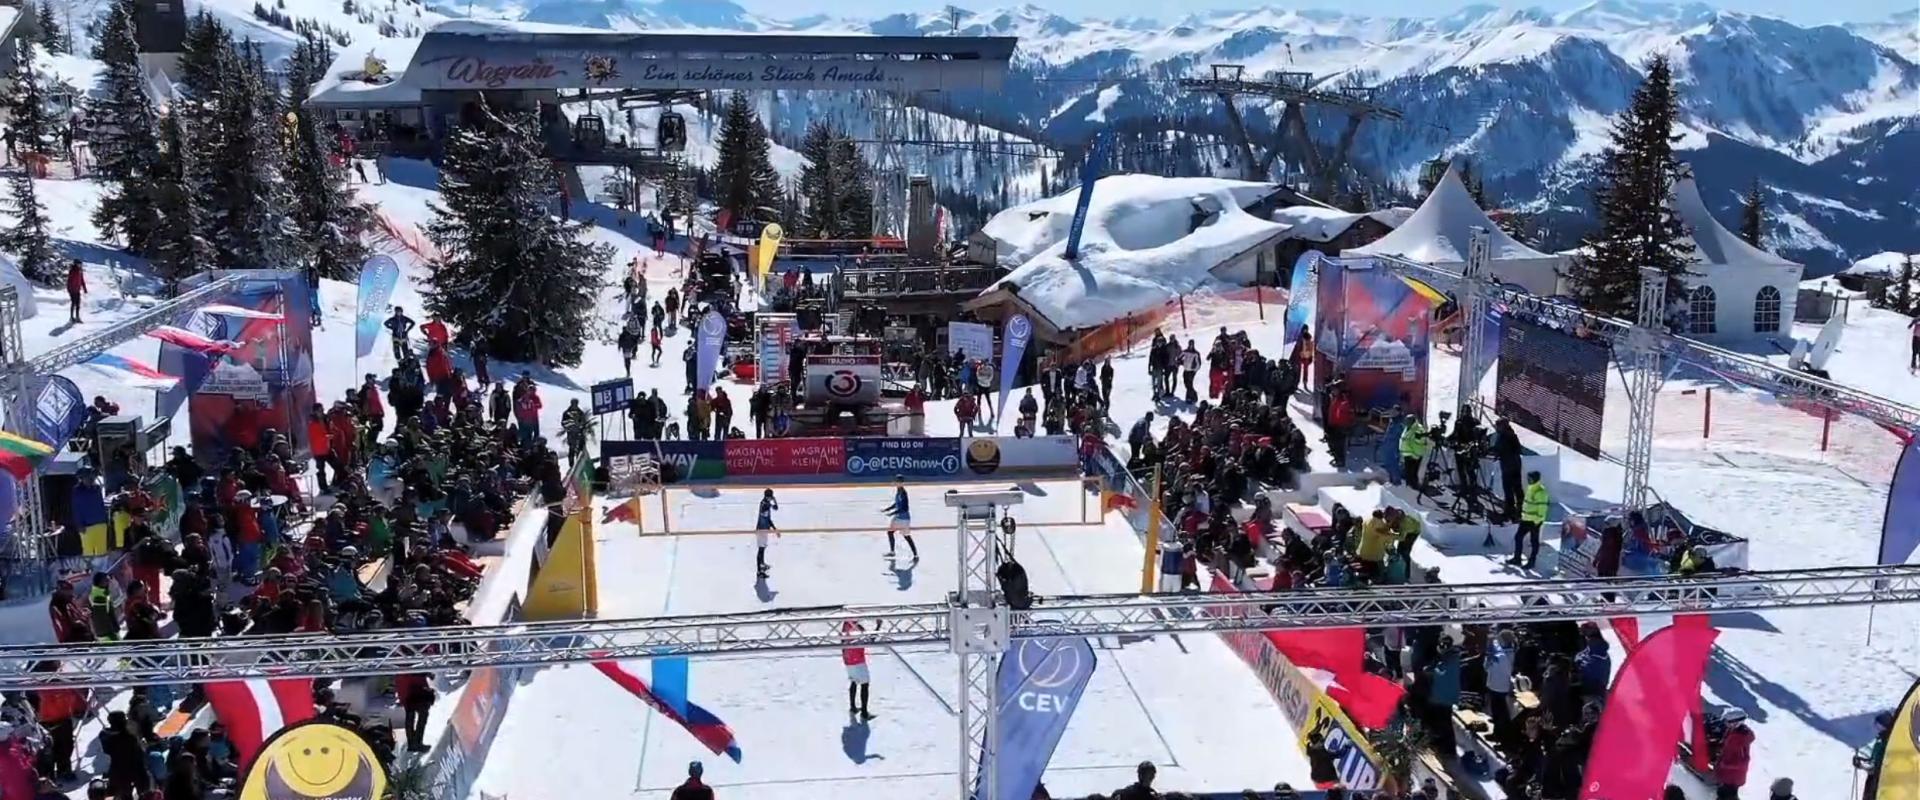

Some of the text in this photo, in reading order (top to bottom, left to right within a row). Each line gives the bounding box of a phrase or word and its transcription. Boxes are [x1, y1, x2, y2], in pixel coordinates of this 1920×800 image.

[436, 54, 567, 87] Wagrain
[643, 64, 677, 81] Ein
[683, 63, 753, 81] schönes
[760, 63, 817, 81] Stück
[726, 445, 838, 457] WAGRAIN WAGRAIN
[868, 456, 938, 471] @CEVSnow
[1018, 691, 1069, 714] CEV
